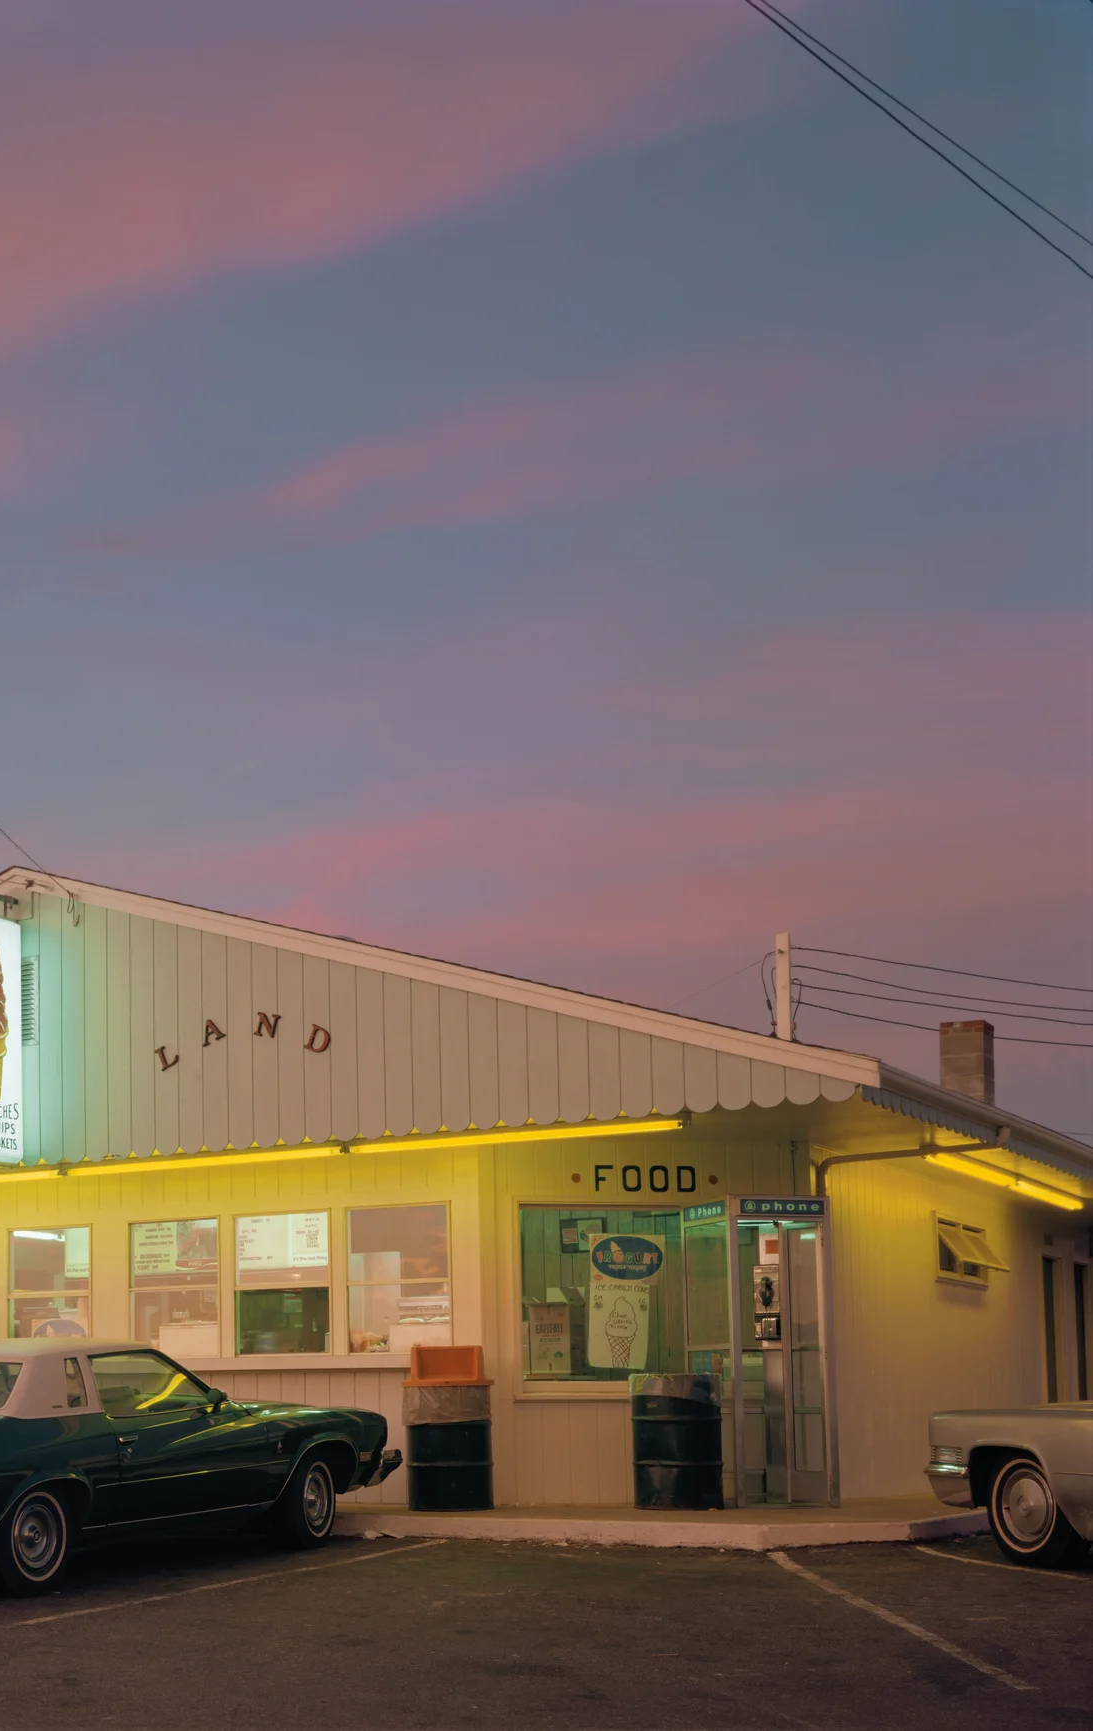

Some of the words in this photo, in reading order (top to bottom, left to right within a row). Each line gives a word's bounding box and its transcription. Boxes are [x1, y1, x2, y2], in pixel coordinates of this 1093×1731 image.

[154, 1011, 331, 1072] LAND
[593, 1164, 697, 1193] FOOD
[761, 1201, 821, 1212] phone
